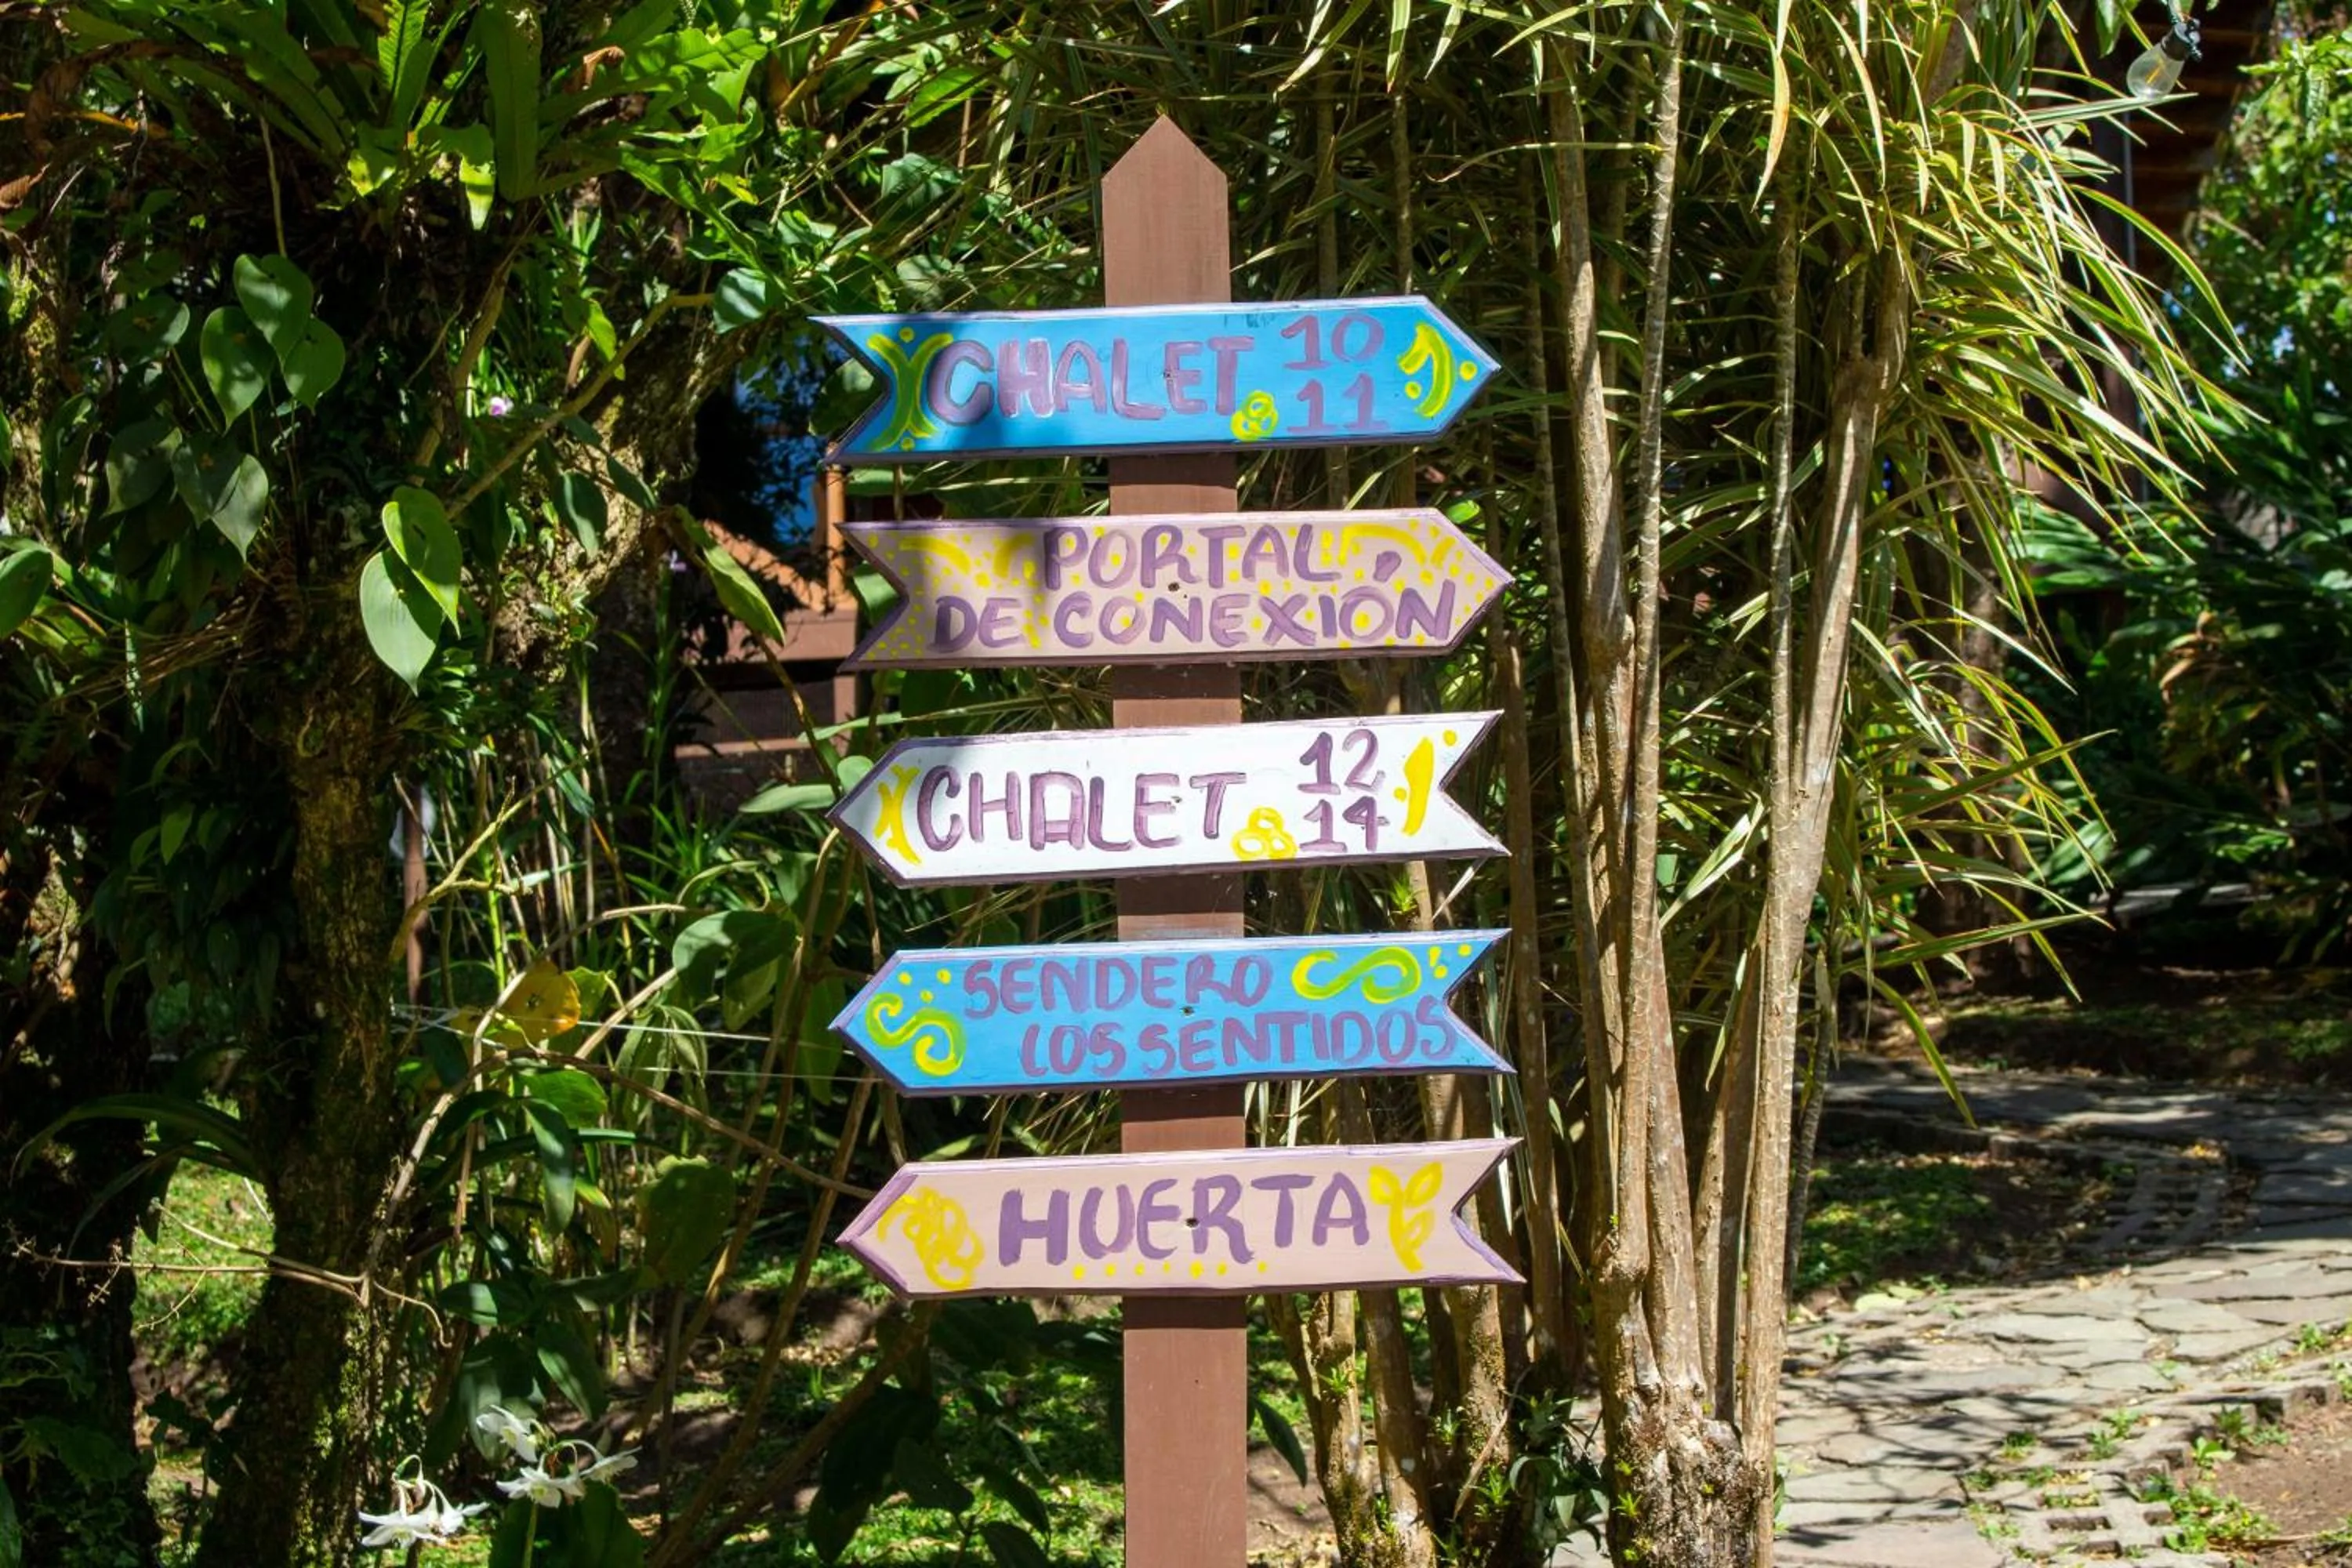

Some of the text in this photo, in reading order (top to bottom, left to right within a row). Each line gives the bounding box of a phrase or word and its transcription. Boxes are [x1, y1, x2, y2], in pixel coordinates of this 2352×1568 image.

[1281, 314, 1385, 371] 10
[927, 337, 1254, 424] CHALET
[1286, 373, 1390, 434] 11
[1044, 523, 1342, 590] PORTAL
[931, 597, 1022, 651] DE
[1298, 729, 1387, 794] 12
[916, 764, 1247, 851] CHALET
[1298, 795, 1388, 852] 14
[963, 954, 1273, 1019] SENDERO
[1022, 995, 1455, 1078] LOS SENTIDOS
[998, 1171, 1369, 1266] HUERTA
